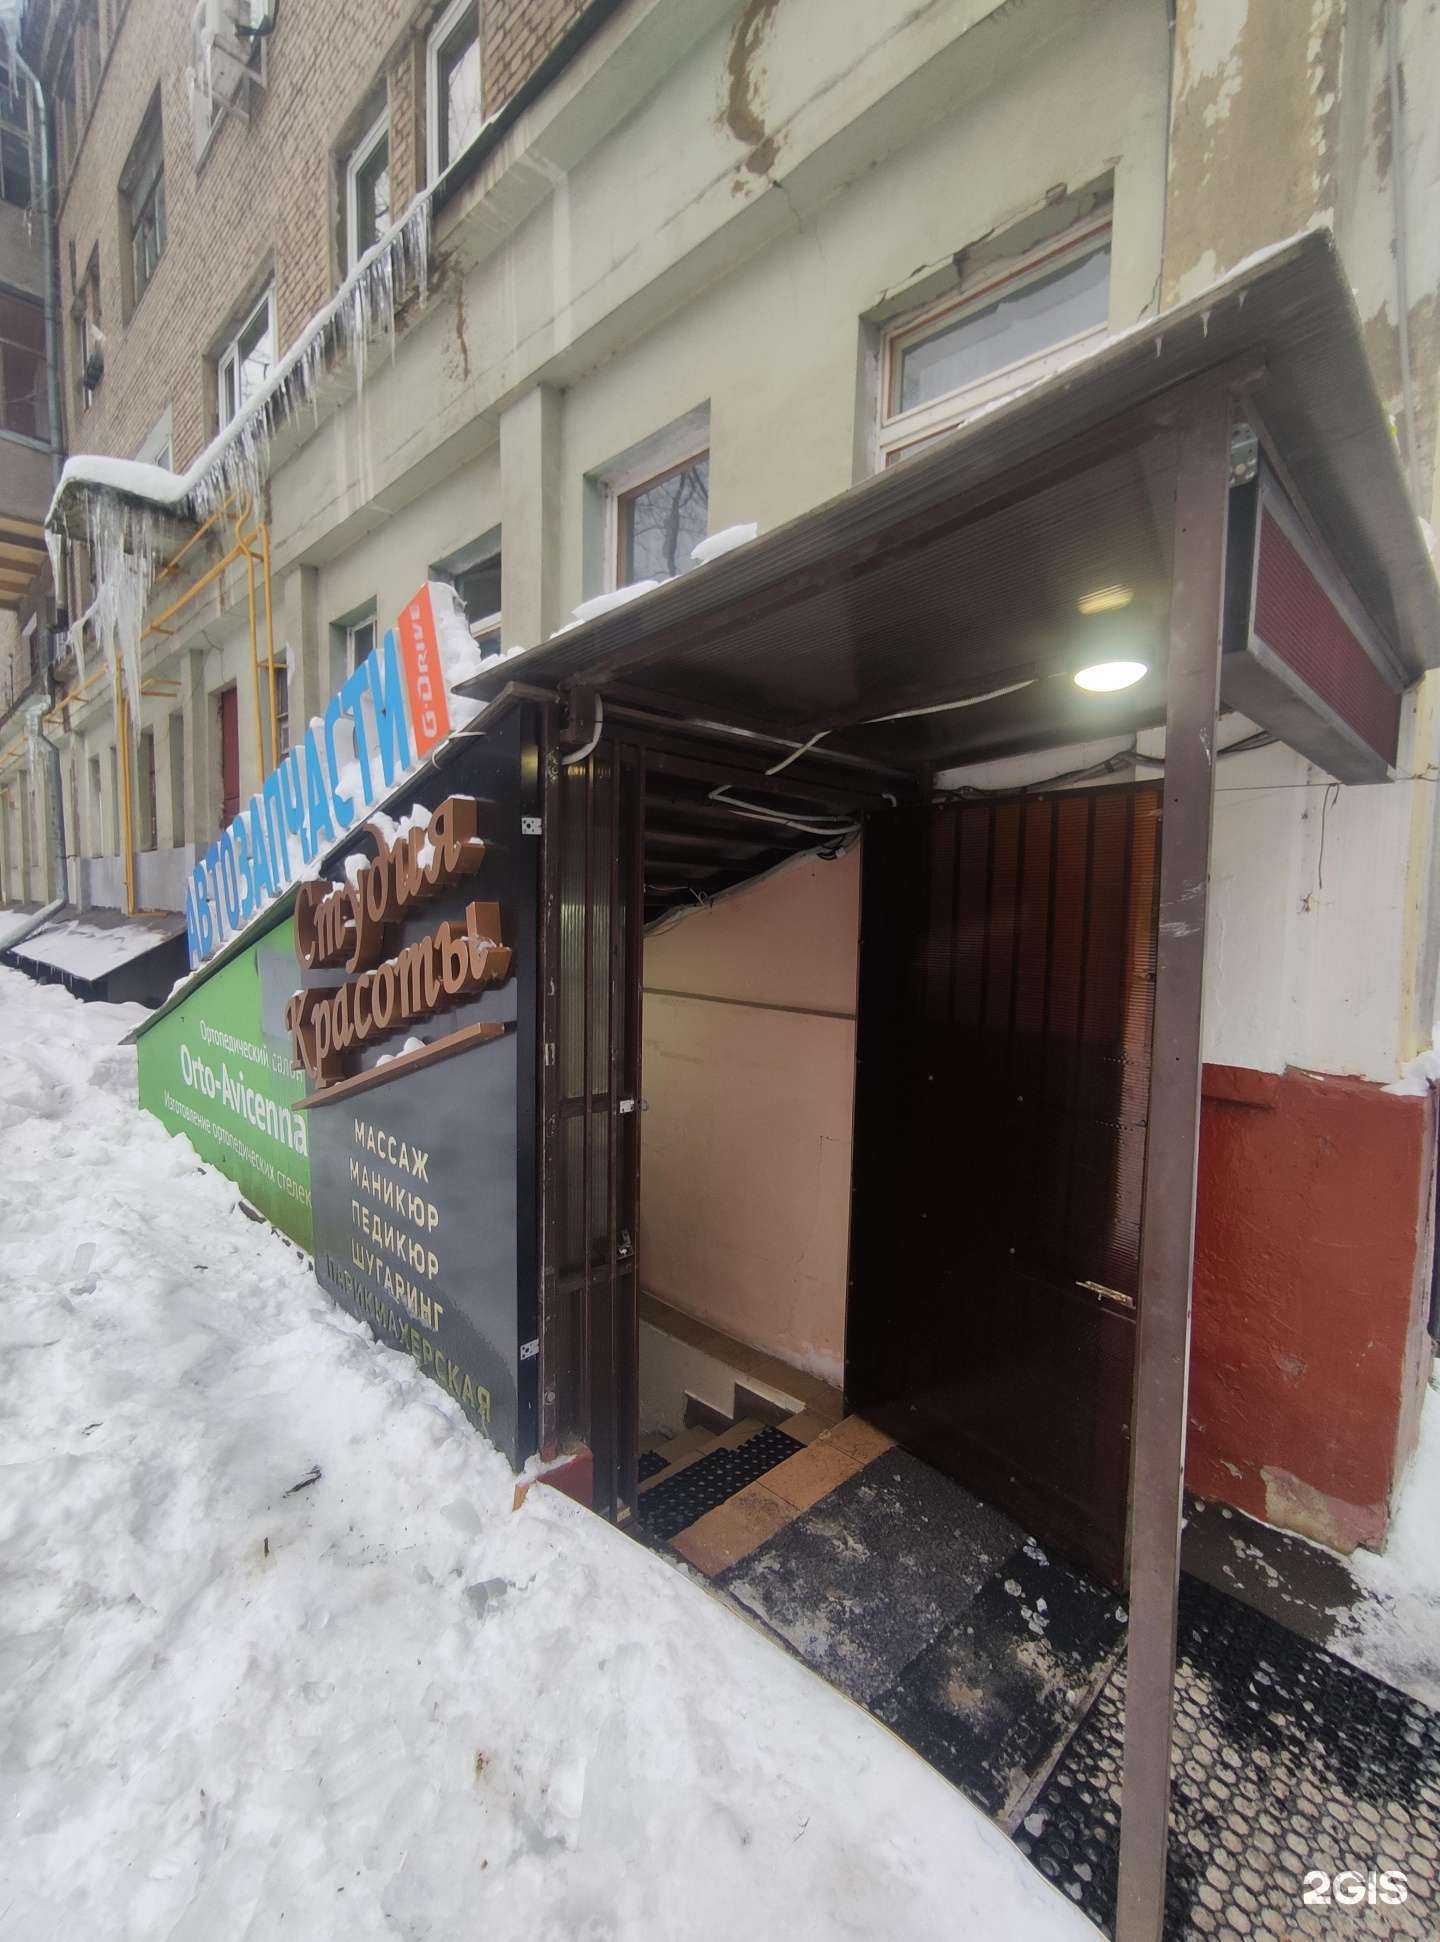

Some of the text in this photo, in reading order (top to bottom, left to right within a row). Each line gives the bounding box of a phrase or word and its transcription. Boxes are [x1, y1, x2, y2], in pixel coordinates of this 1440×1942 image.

[186, 627, 411, 971] АВТОЗАПЧАСТИ
[294, 797, 464, 974] Студия
[200, 1019, 269, 1070] Ортопедический
[284, 902, 492, 1087] Красоты
[163, 1088, 312, 1208] Изготовление ортопедических стелек
[180, 1044, 308, 1157] Orto-Avicenna
[354, 1118, 429, 1184] МАССАЖ
[350, 1157, 439, 1233] МАНИКЮР
[351, 1199, 439, 1281] ПЕДИКЮР
[327, 1254, 491, 1424] ПАРИКМАХЕРСКАЯ
[351, 1238, 444, 1332] ШУГАРИНГ
